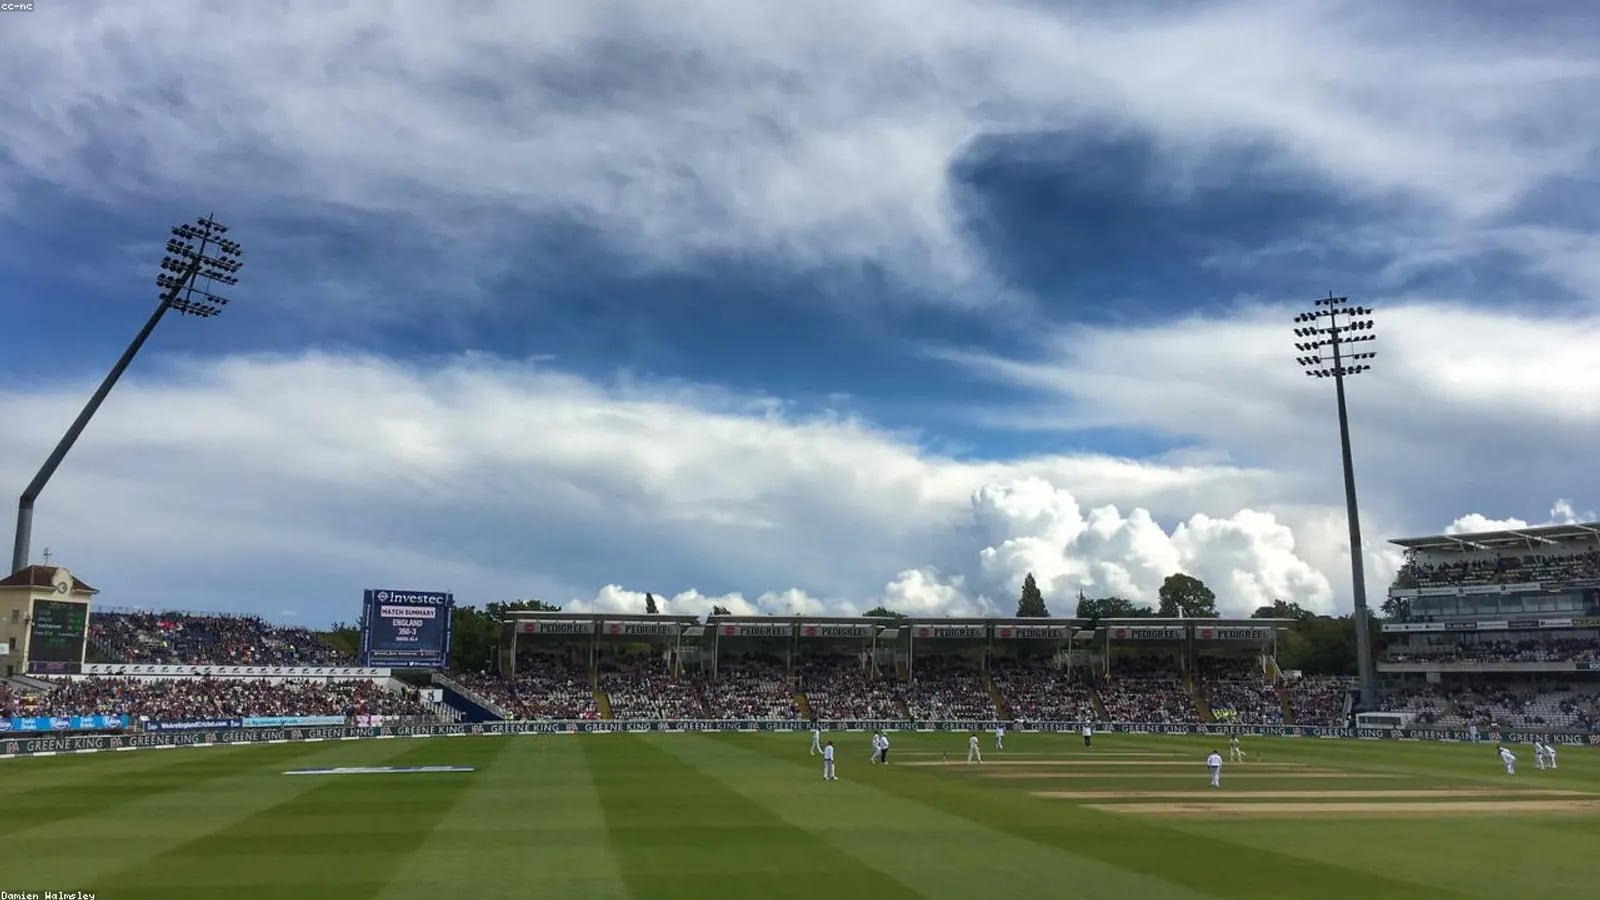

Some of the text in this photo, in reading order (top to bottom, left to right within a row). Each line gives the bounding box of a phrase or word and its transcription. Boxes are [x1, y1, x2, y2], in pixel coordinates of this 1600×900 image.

[390, 592, 444, 604] Investec
[392, 619, 423, 627] ENGLAND
[540, 623, 585, 633] PEDIGREE
[398, 726, 435, 735] GREENE
[438, 725, 464, 734] KING
[491, 724, 529, 733] GREENE
[533, 724, 559, 732] KING
[584, 723, 622, 731] GREENE
[627, 722, 650, 731] KING
[676, 722, 713, 730] GREENE
[717, 722, 740, 730] KING
[766, 722, 801, 730] GREENE
[854, 722, 890, 730] GREENE
[895, 722, 918, 730] KING
[942, 722, 979, 730] GREENE
[1032, 723, 1069, 731] GREENE
[1121, 724, 1160, 732] GREENE
[1164, 724, 1189, 732] KING
[1216, 726, 1255, 734] GREENE
[1260, 727, 1285, 735] KING
[222, 731, 259, 743] GREENE
[261, 730, 285, 740] KING
[309, 728, 347, 738] GREENE
[350, 727, 374, 737] KING
[1313, 728, 1353, 736] GREENE
[1357, 729, 1383, 738] KING
[1410, 730, 1450, 739] GREENE
[129, 735, 170, 747] GREENE
[173, 733, 199, 745] KING
[1508, 732, 1550, 742] GREENE
[1553, 734, 1582, 744] KING
[27, 739, 70, 752] GREENE
[73, 737, 104, 750] KING
